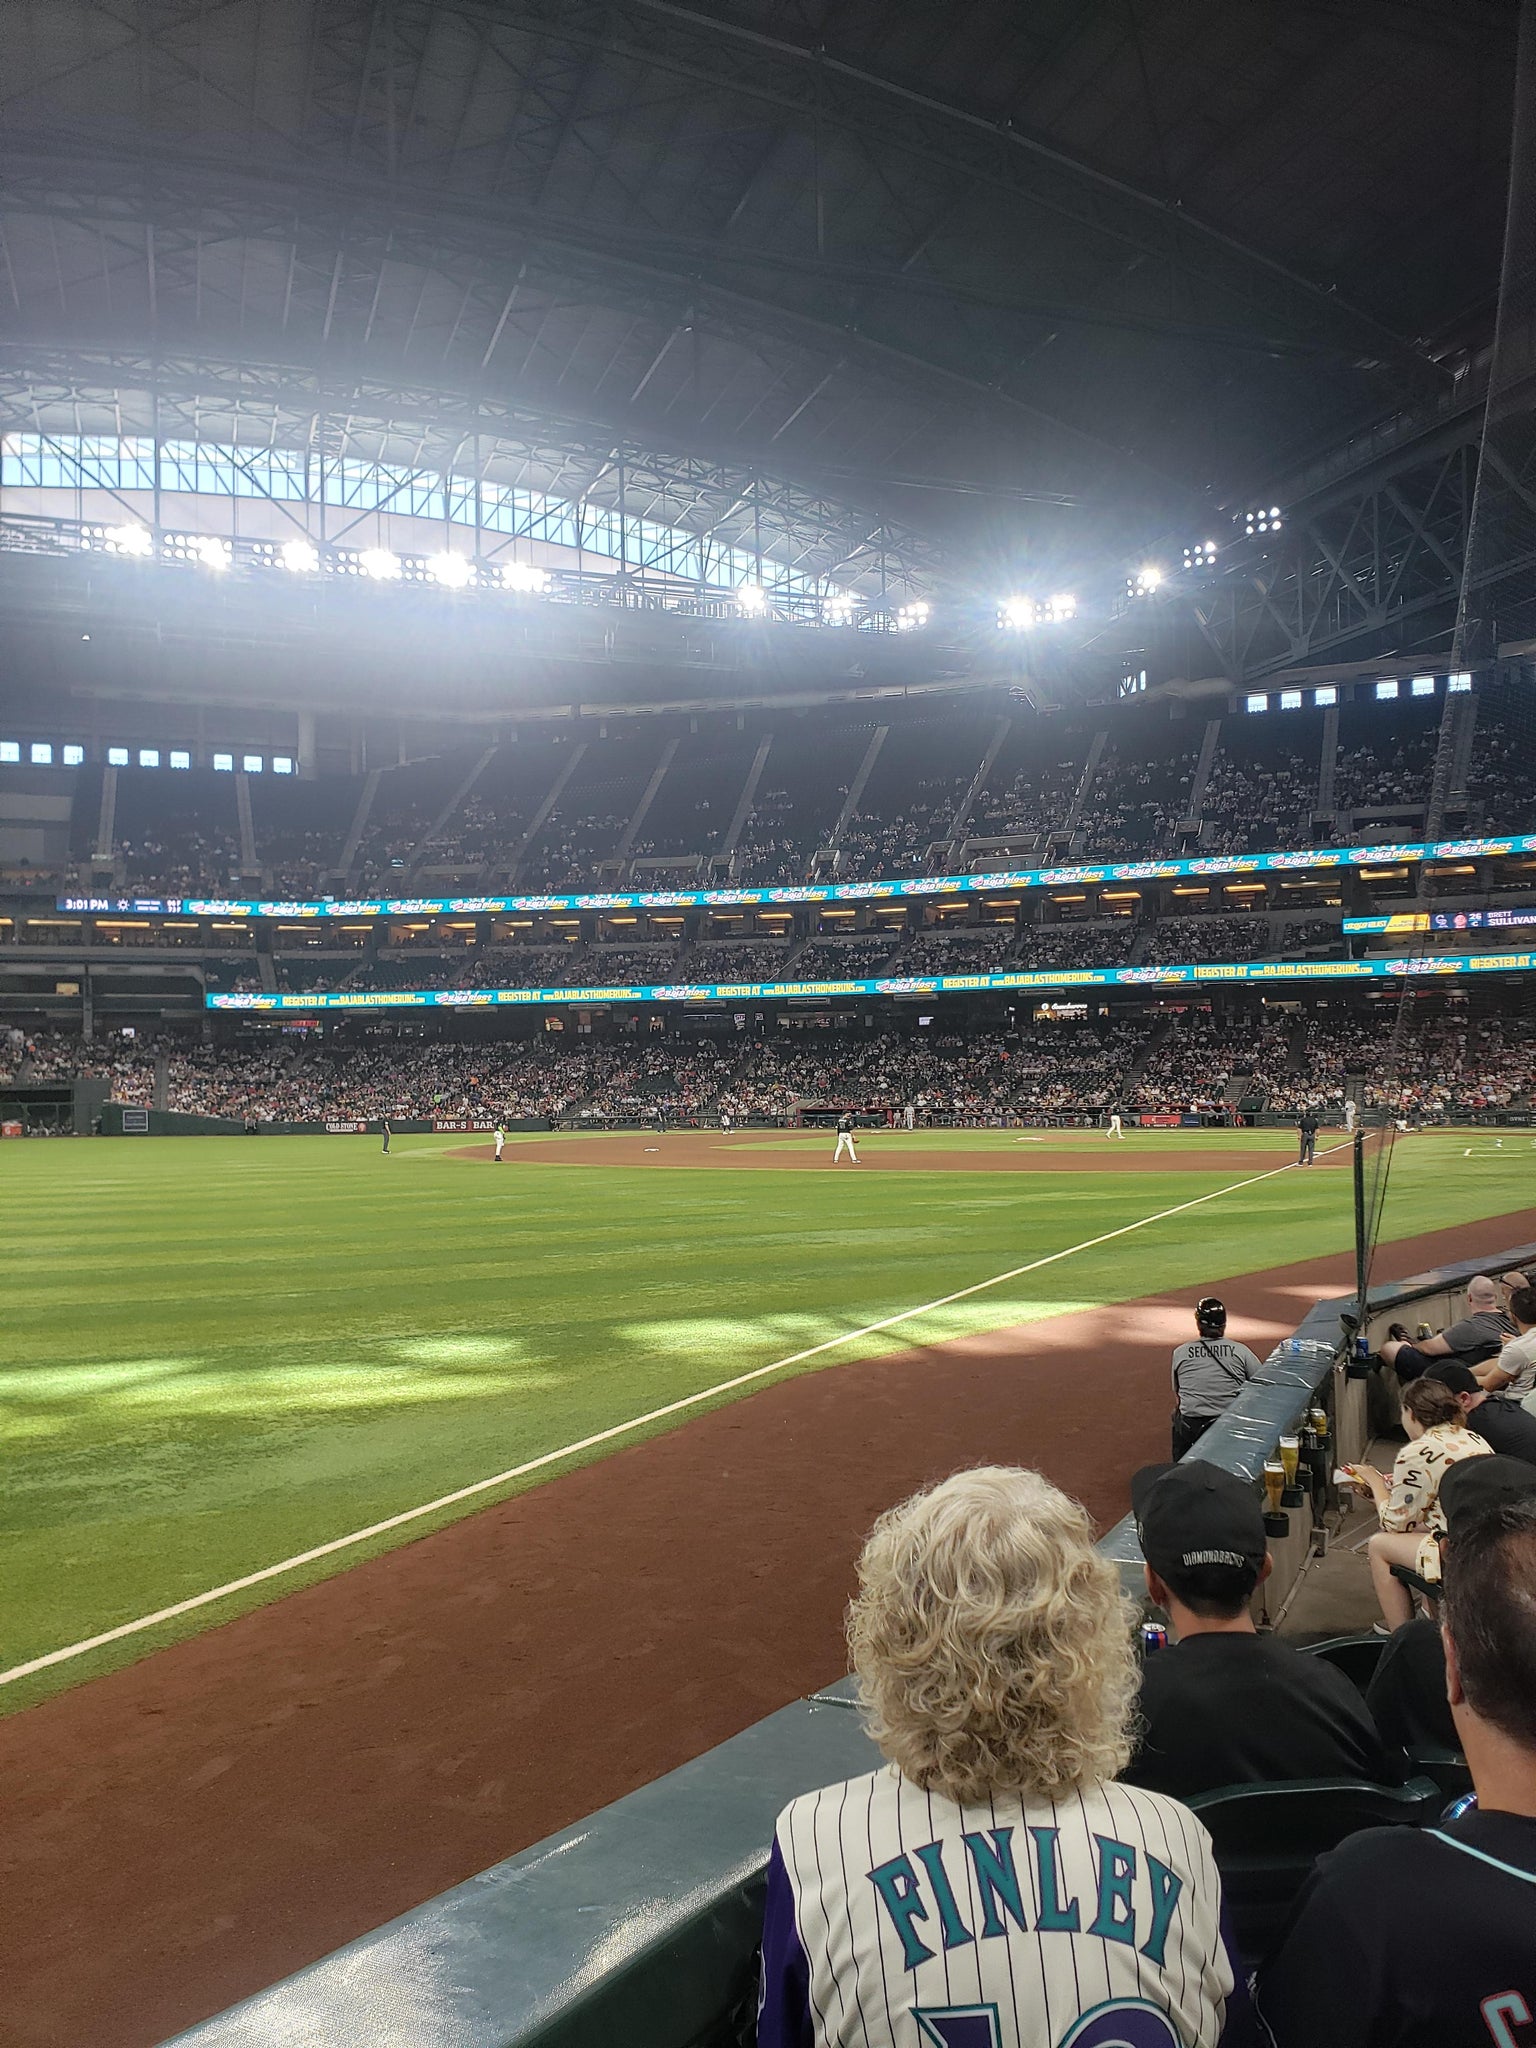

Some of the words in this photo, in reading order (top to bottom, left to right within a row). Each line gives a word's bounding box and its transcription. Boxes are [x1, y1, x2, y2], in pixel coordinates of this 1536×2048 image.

[65, 899, 88, 910] 3:01
[90, 899, 109, 911] PM
[1469, 912, 1482, 920] 26
[1488, 911, 1513, 919] BRETT
[1488, 915, 1536, 926] SULLIVAN
[1470, 957, 1516, 969] REGISTER
[1517, 955, 1531, 967] AT
[1194, 966, 1236, 977] REGISTER
[1237, 966, 1248, 977] AT
[943, 978, 979, 989] REGISTER
[980, 976, 990, 987] AT
[498, 991, 531, 1001] REGISTER
[532, 991, 541, 1001] AT
[717, 986, 750, 996] REGISTER
[751, 986, 761, 995] AT
[282, 996, 317, 1007] REGISTER
[317, 996, 328, 1006] AT
[340, 1122, 358, 1131] STONE
[436, 1121, 467, 1130] BAR-S
[473, 1121, 495, 1130] BAR
[1188, 1344, 1236, 1358] SECURITY
[865, 1826, 1184, 1972] FINLEY
